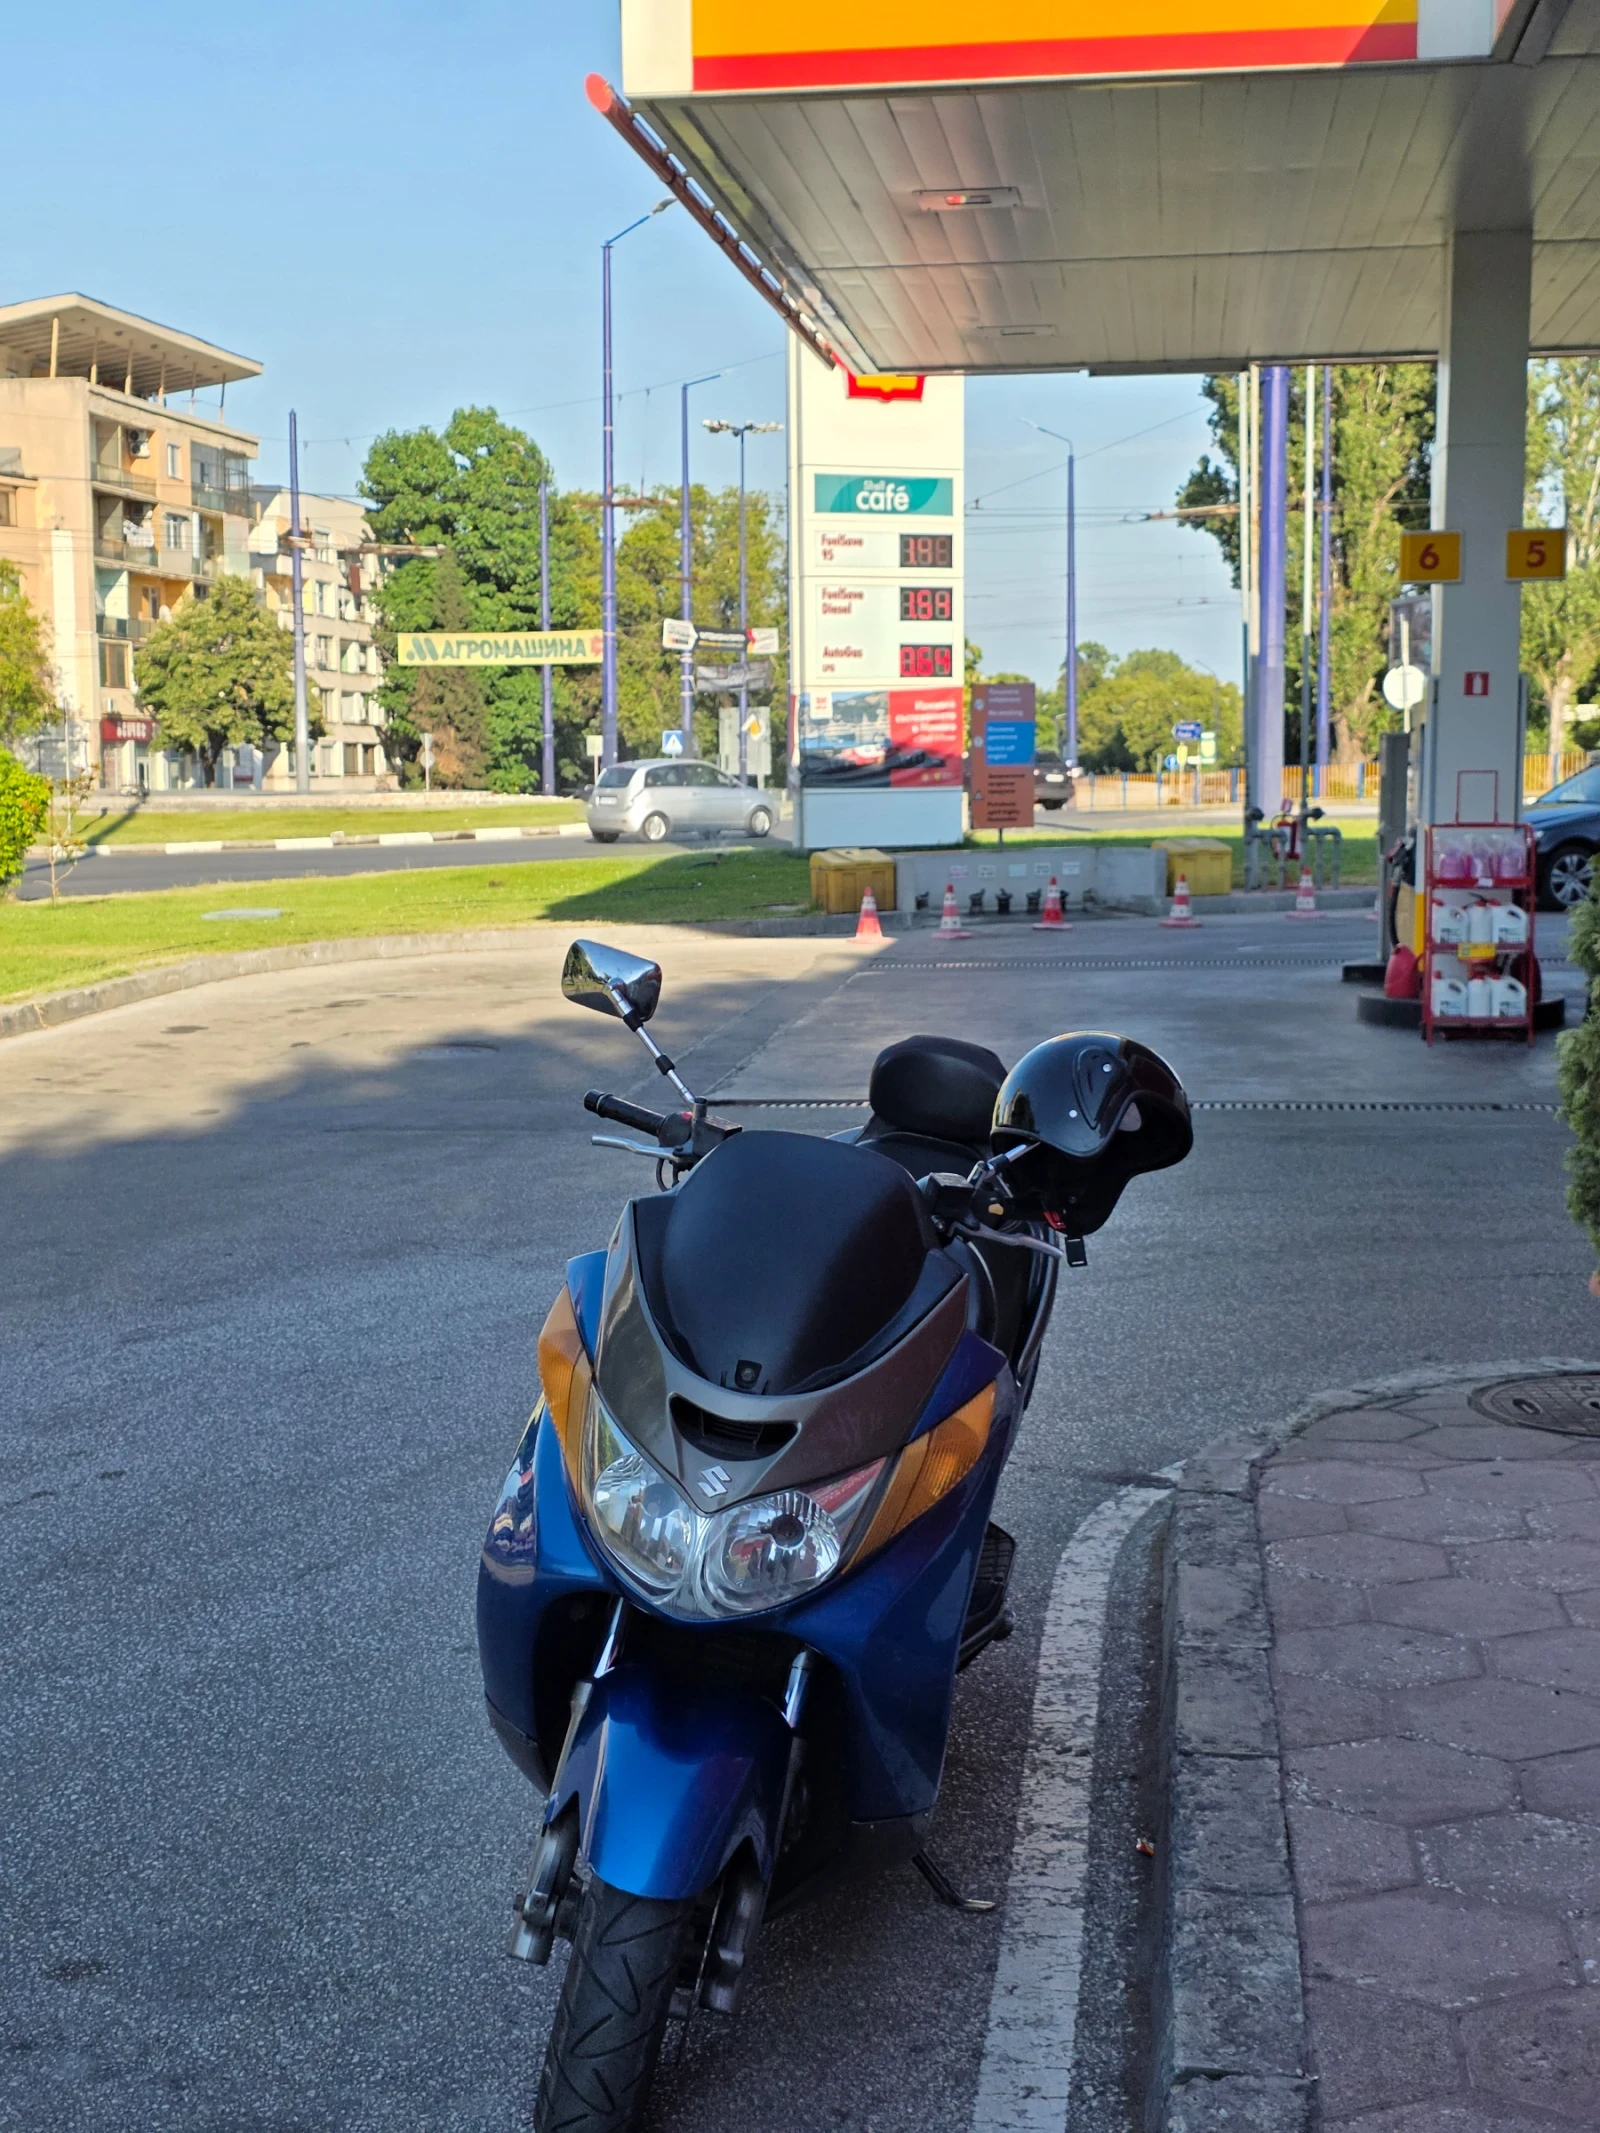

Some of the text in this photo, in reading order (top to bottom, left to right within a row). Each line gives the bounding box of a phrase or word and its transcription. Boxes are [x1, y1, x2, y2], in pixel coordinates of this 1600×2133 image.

[855, 483, 910, 512] café
[821, 533, 864, 547] FuelSave
[821, 549, 834, 561] 95
[1418, 543, 1440, 570] 6
[1526, 540, 1547, 568] 5
[821, 587, 864, 600] FuelSave
[821, 602, 852, 615] Diesel
[441, 637, 586, 660] АГРОМАШИНА
[822, 646, 863, 659] AutoGas
